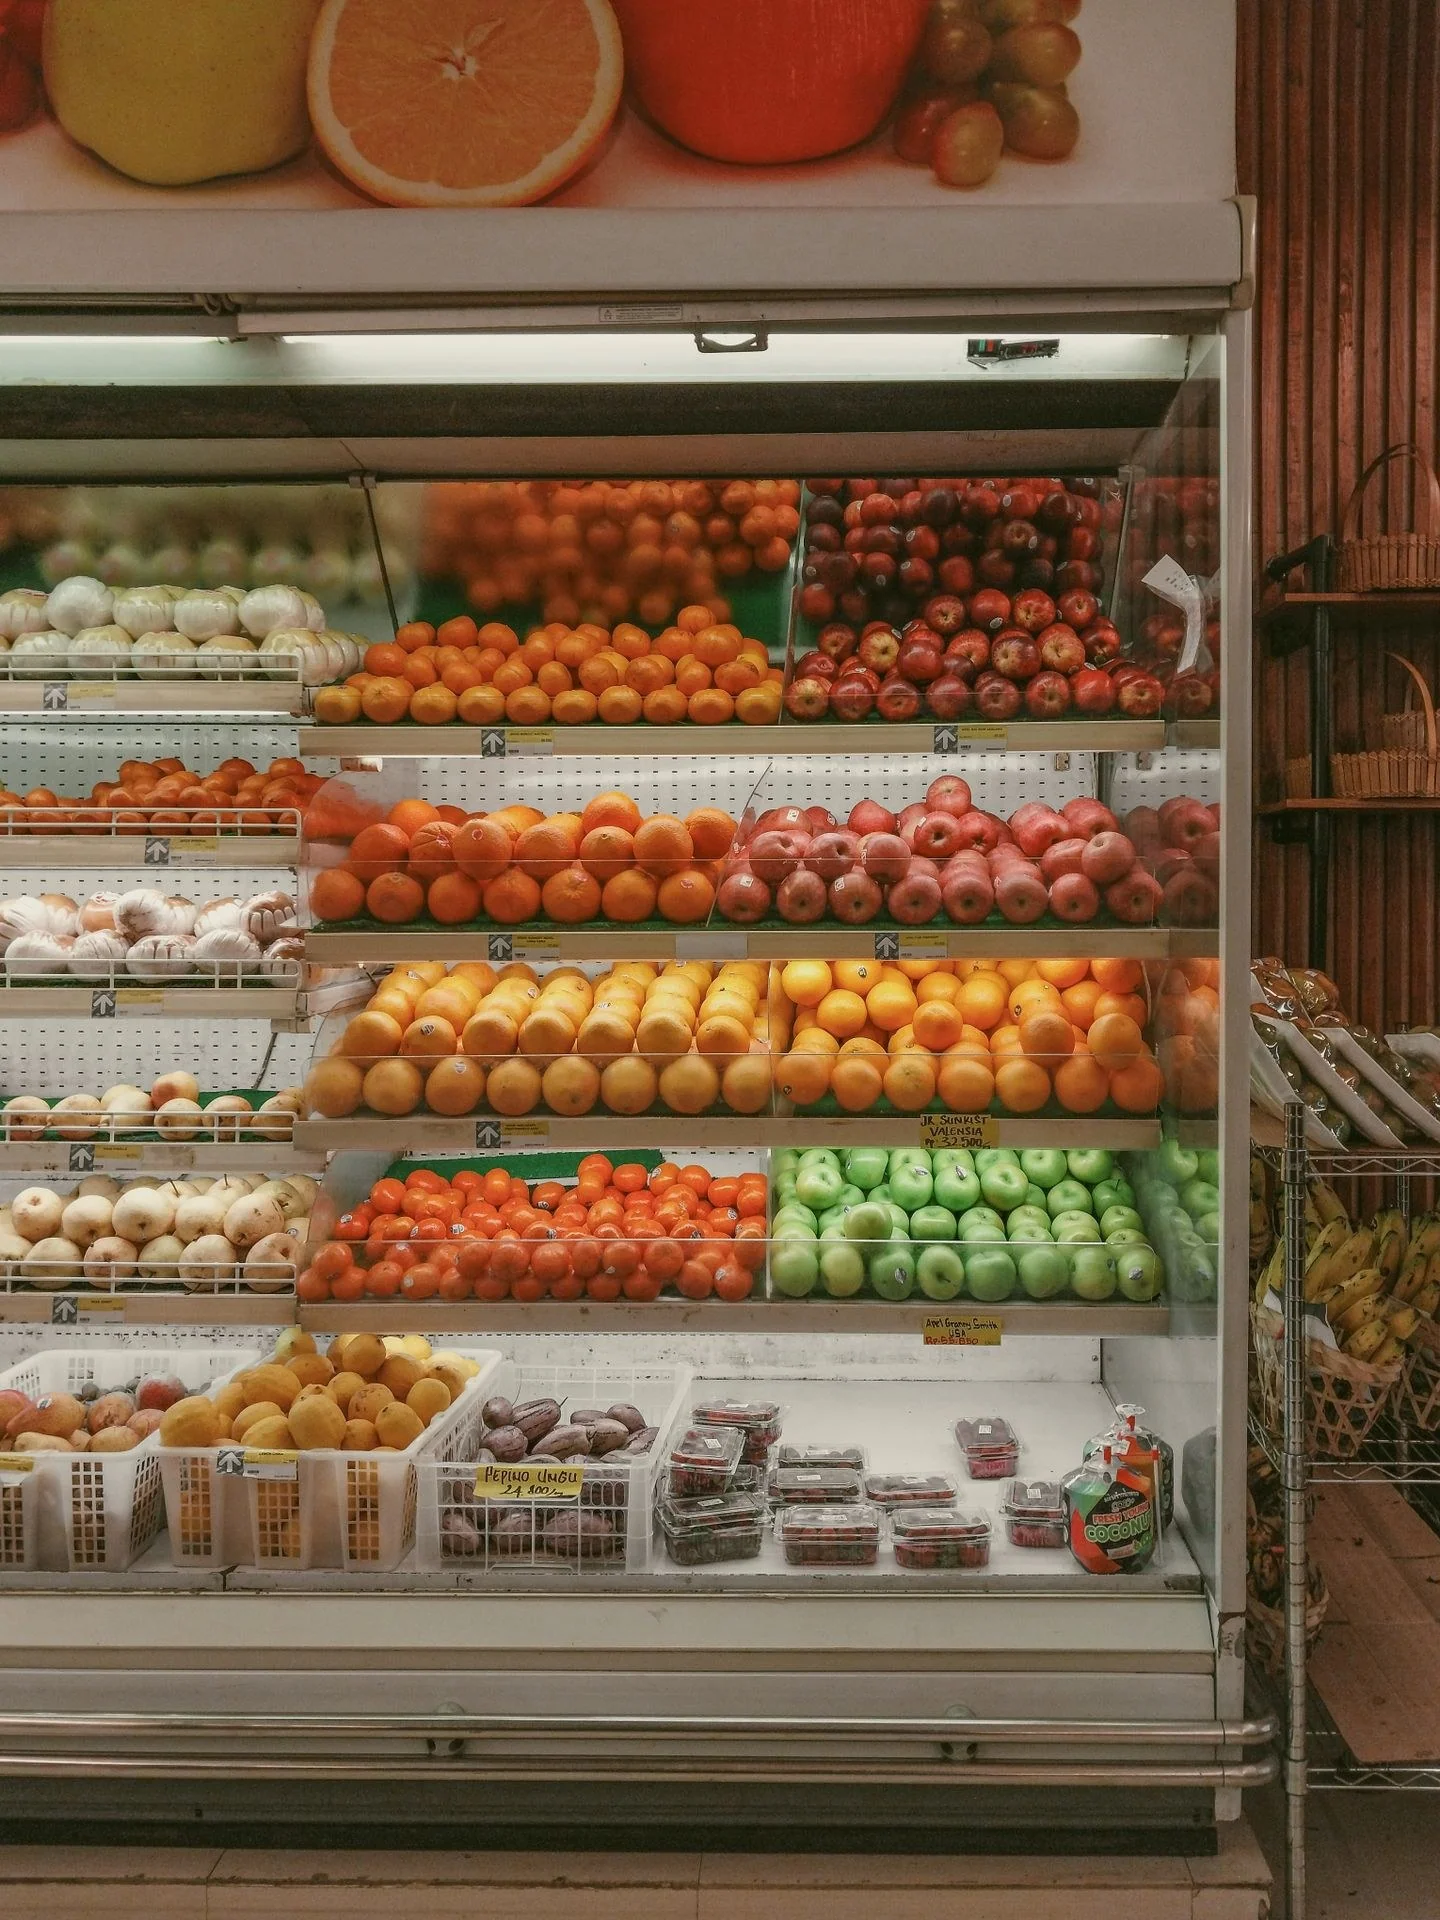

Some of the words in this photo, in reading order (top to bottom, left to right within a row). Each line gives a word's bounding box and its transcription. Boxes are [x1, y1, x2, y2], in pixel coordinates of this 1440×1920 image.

[920, 1115, 935, 1127] JR
[940, 1114, 989, 1125] SUNKIST
[929, 1126, 983, 1136] VALENSIA
[944, 1317, 971, 1330] Granny
[972, 1317, 999, 1330] Smith
[949, 1329, 967, 1338] USA
[485, 1466, 530, 1485] PEPINO
[537, 1468, 578, 1484] UNGU
[1092, 1512, 1123, 1525] FRESH
